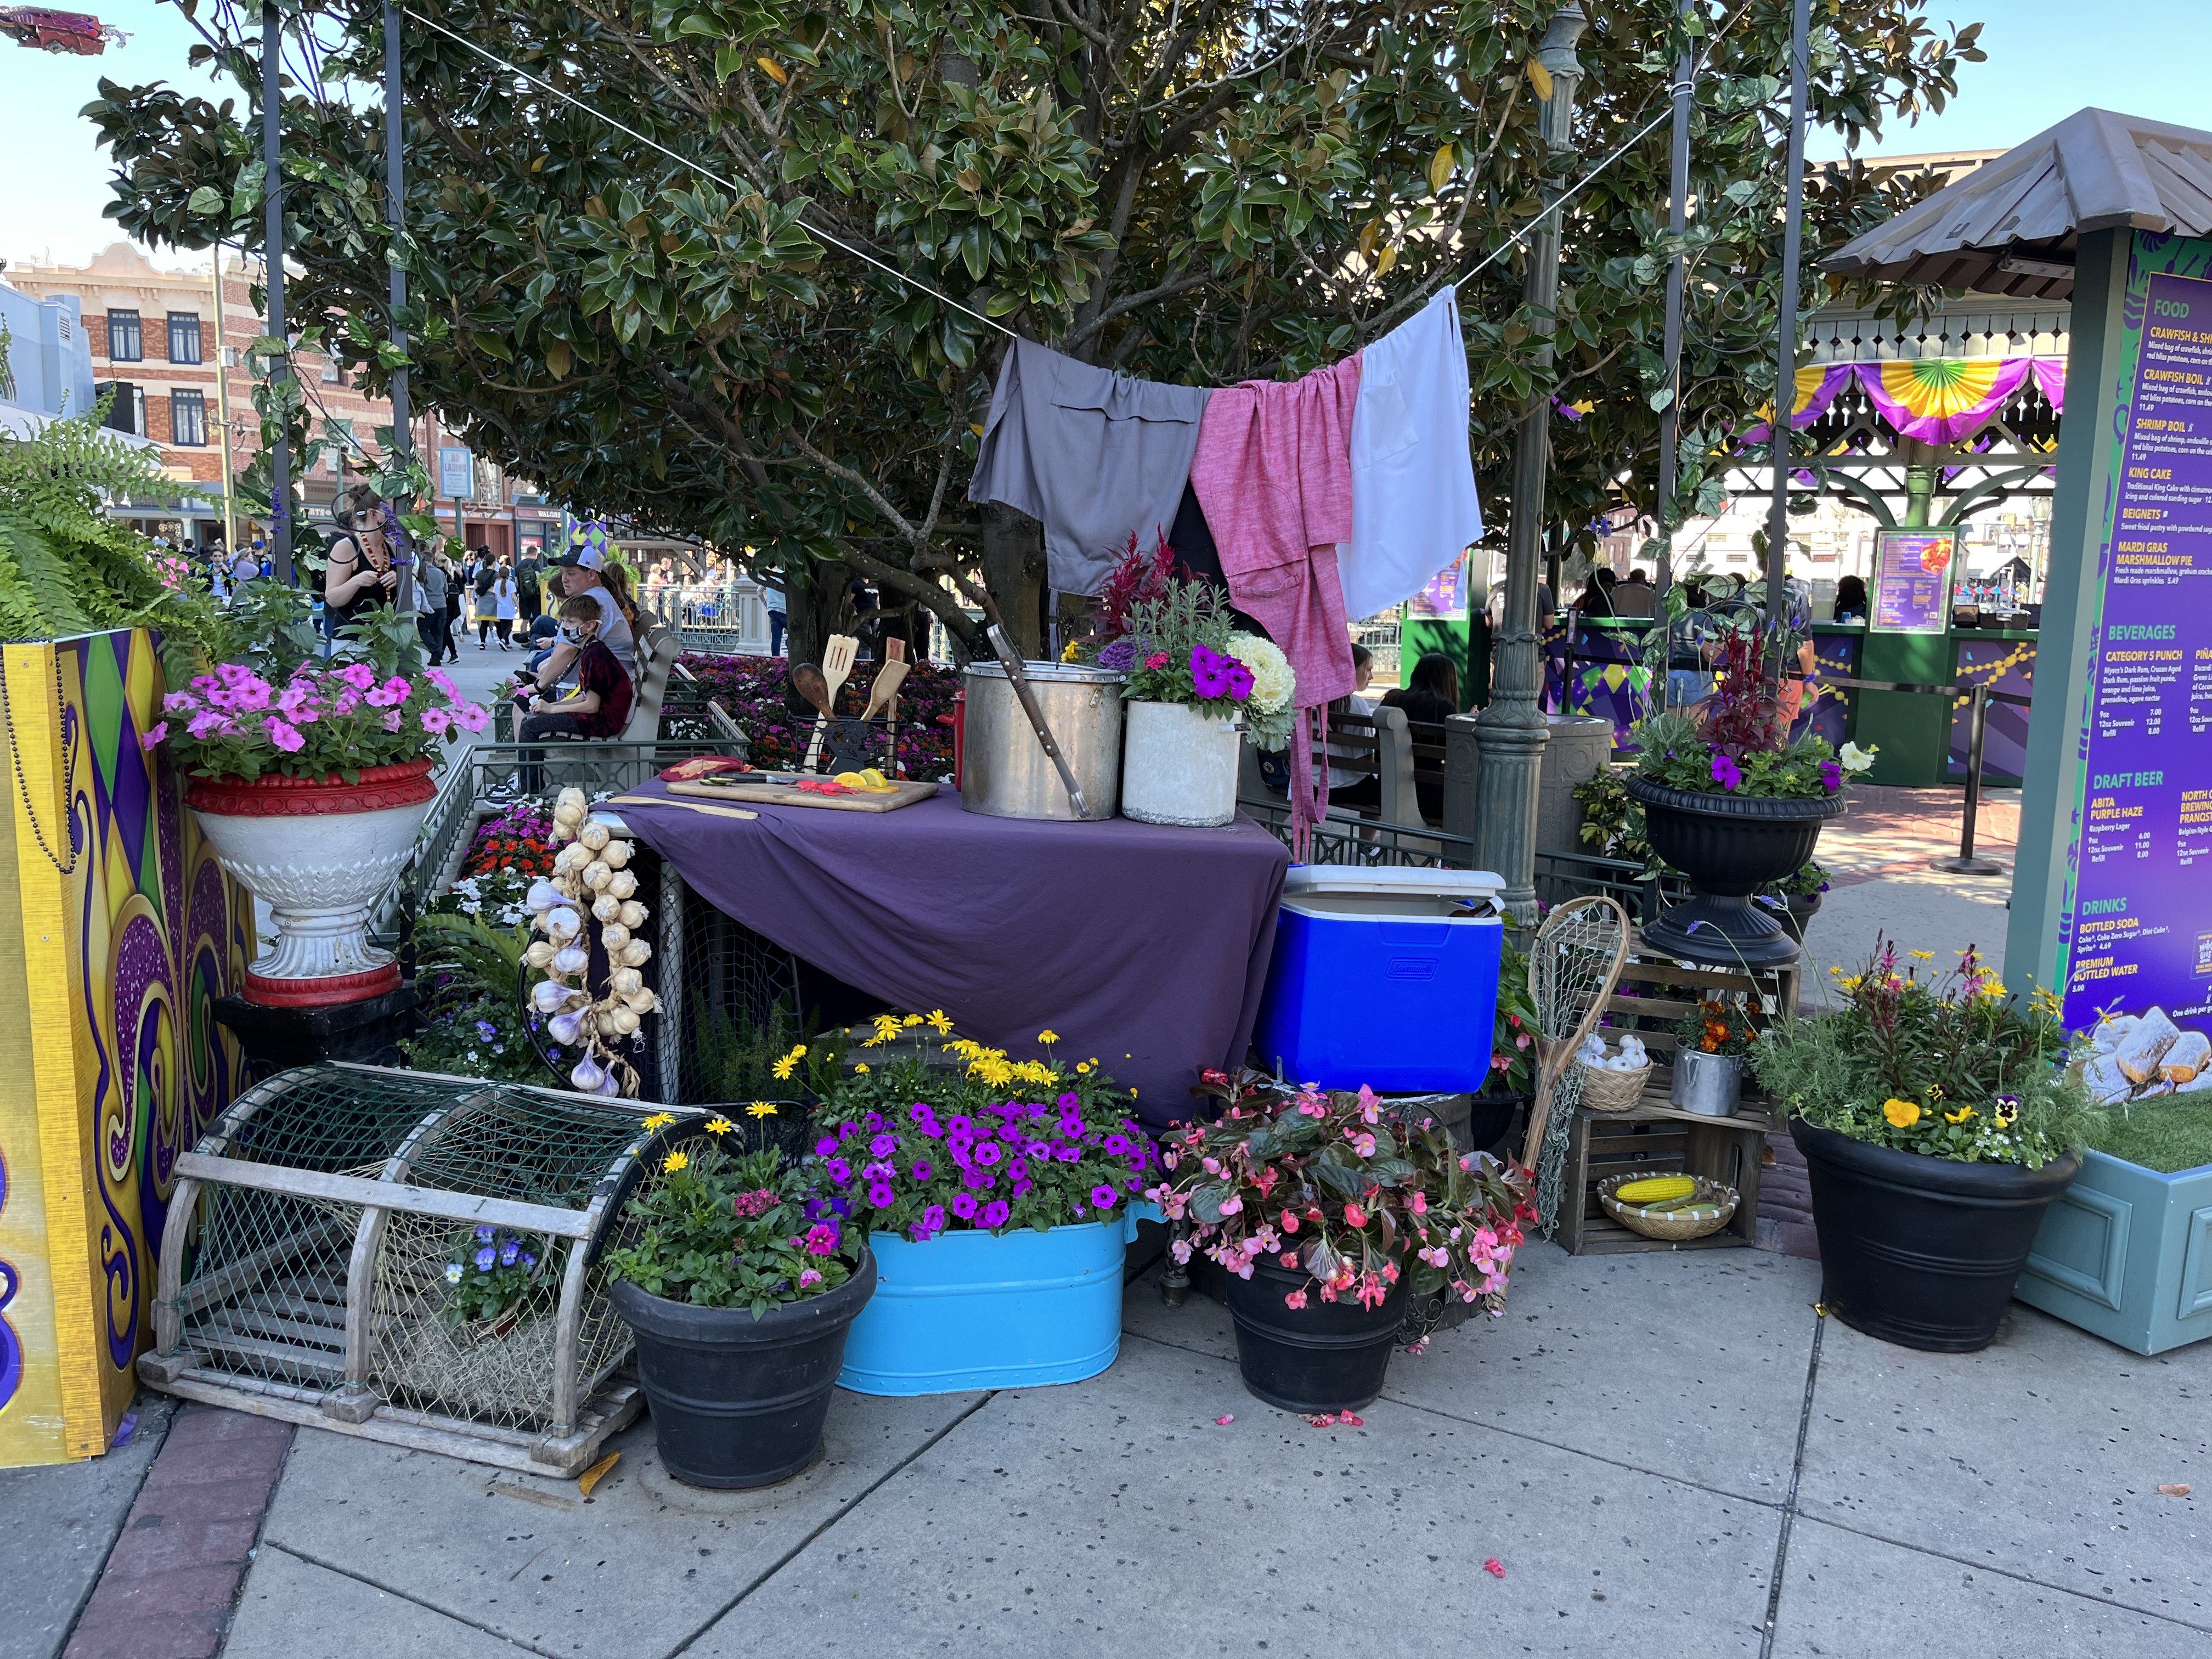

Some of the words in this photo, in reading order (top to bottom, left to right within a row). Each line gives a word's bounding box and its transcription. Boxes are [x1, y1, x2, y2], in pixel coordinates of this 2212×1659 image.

[2154, 300, 2189, 318] FOOD
[2151, 326, 2191, 342] CRAWFISH
[2192, 332, 2198, 342] &
[2148, 341, 2164, 349] Mixed
[2164, 342, 2174, 353] bag
[2180, 346, 2202, 355] crawfish,
[2155, 352, 2167, 360] bliss
[2166, 355, 2190, 364] potatoes,
[2144, 369, 2185, 383] CRAWFISH
[2186, 373, 2203, 385] BOIL
[2142, 382, 2158, 391] Mixed
[2158, 384, 2169, 394] bag
[2175, 386, 2197, 396] crawfish,
[2149, 393, 2162, 402] bliss
[2161, 396, 2185, 405] potatoes,
[2140, 403, 2154, 411] 11.49
[2136, 418, 2167, 430] SHRIMP
[2168, 421, 2186, 432] BOIL
[2134, 432, 2151, 441] Mixed
[2151, 433, 2161, 443] bag
[2168, 435, 2186, 445] shrimp,
[2186, 437, 2209, 445] andouille
[2142, 443, 2154, 451] bliss
[2132, 453, 2147, 461] 11.49
[2129, 467, 2149, 478] KING
[2151, 469, 2172, 479] CAKE
[2127, 482, 2154, 490] Traditional
[2154, 483, 2166, 493] King
[2125, 492, 2138, 502] icing
[2168, 494, 2188, 504] sanding
[2123, 508, 2161, 520] BEIGNETS
[2150, 524, 2166, 533] pastry
[2177, 524, 2203, 533] powdered
[2118, 541, 2145, 552] MARDI
[2147, 542, 2168, 553] GRAS
[2117, 554, 2180, 566] MARSHMALLOW
[2180, 556, 2193, 566] PIE
[2145, 567, 2179, 575] marshmallow,
[2179, 568, 2197, 576] graham
[2142, 577, 2164, 586] sprinkles
[2108, 625, 2176, 640] BEVERAGES
[2106, 651, 2148, 662] CATEGORY
[2149, 651, 2154, 661] 5
[2155, 650, 2182, 661] PUNCH
[2196, 647, 2212, 659] PIÑA
[2104, 667, 2124, 676] Myers's
[2168, 665, 2181, 674] Aged
[2130, 675, 2149, 685] passion
[2101, 695, 2128, 705] grenadine,
[2191, 692, 2204, 702] juice,
[2094, 773, 2133, 789] DRAFT
[2135, 771, 2163, 786] BEER
[2182, 790, 2208, 801] NORTH
[2091, 797, 2115, 809] ABITA
[2091, 808, 2120, 820] PURPLE
[2121, 806, 2143, 817] HAZE
[2089, 824, 2115, 833] Raspberry
[2115, 823, 2130, 831] Lager
[2179, 826, 2209, 836] Belgian-Style
[2101, 844, 2124, 853] Souvenir
[2189, 847, 2209, 855] Souvenir
[2091, 854, 2105, 862] Refill
[2083, 897, 2127, 916] DRINKS
[2080, 921, 2115, 934] BOTTLED
[2117, 918, 2138, 929] SODA
[1393, 962, 1424, 973] Coleman
[2075, 957, 2114, 970] PREMIUM
[2074, 969, 2109, 982] BOTTLED
[2111, 964, 2138, 977] WATER
[2072, 984, 2085, 992] 5.00
[2184, 1007, 2197, 1015] drink
[2198, 1007, 2206, 1015] per
